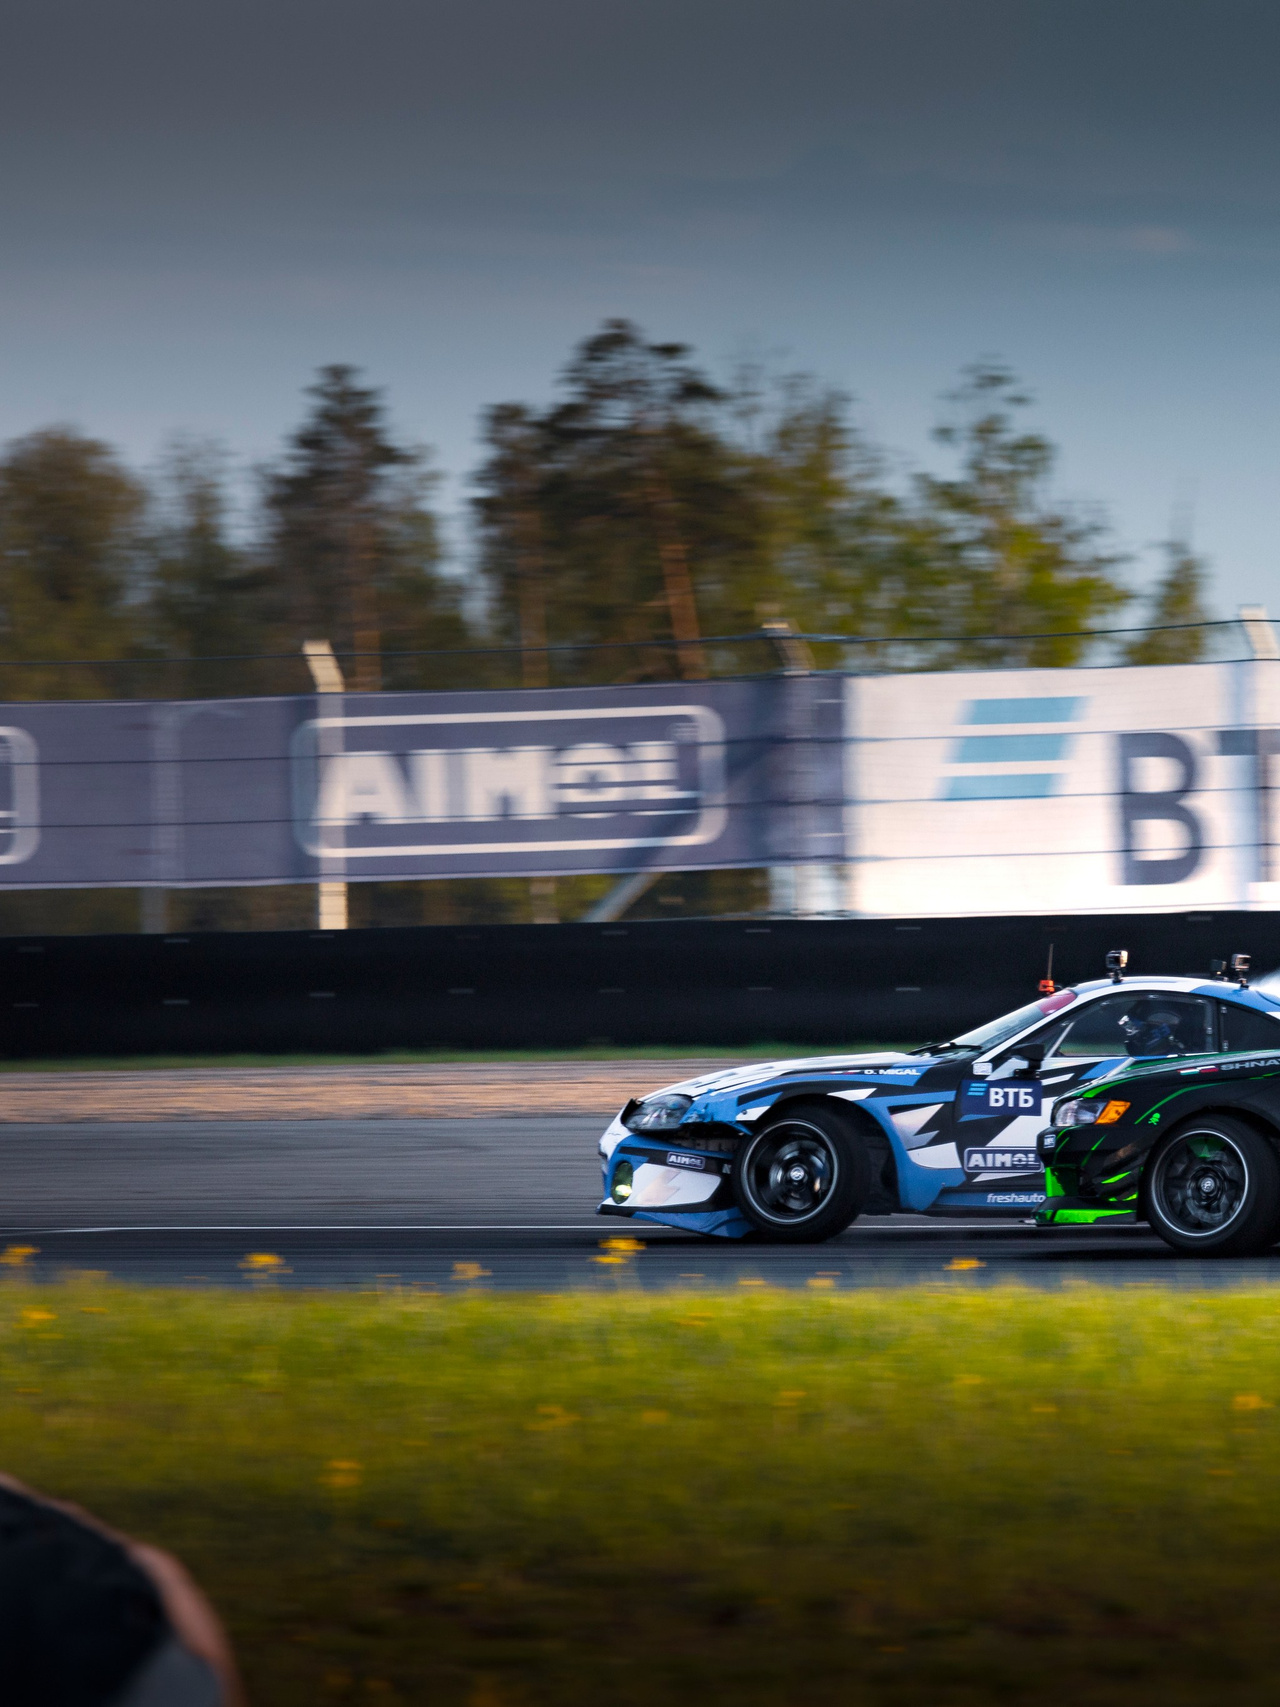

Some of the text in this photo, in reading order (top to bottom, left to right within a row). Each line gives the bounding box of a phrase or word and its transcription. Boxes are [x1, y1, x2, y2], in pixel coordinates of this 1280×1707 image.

[989, 1087, 1034, 1107] ВТБ
[968, 1153, 1040, 1168] AIMOL
[986, 1193, 1047, 1203] freshauto
